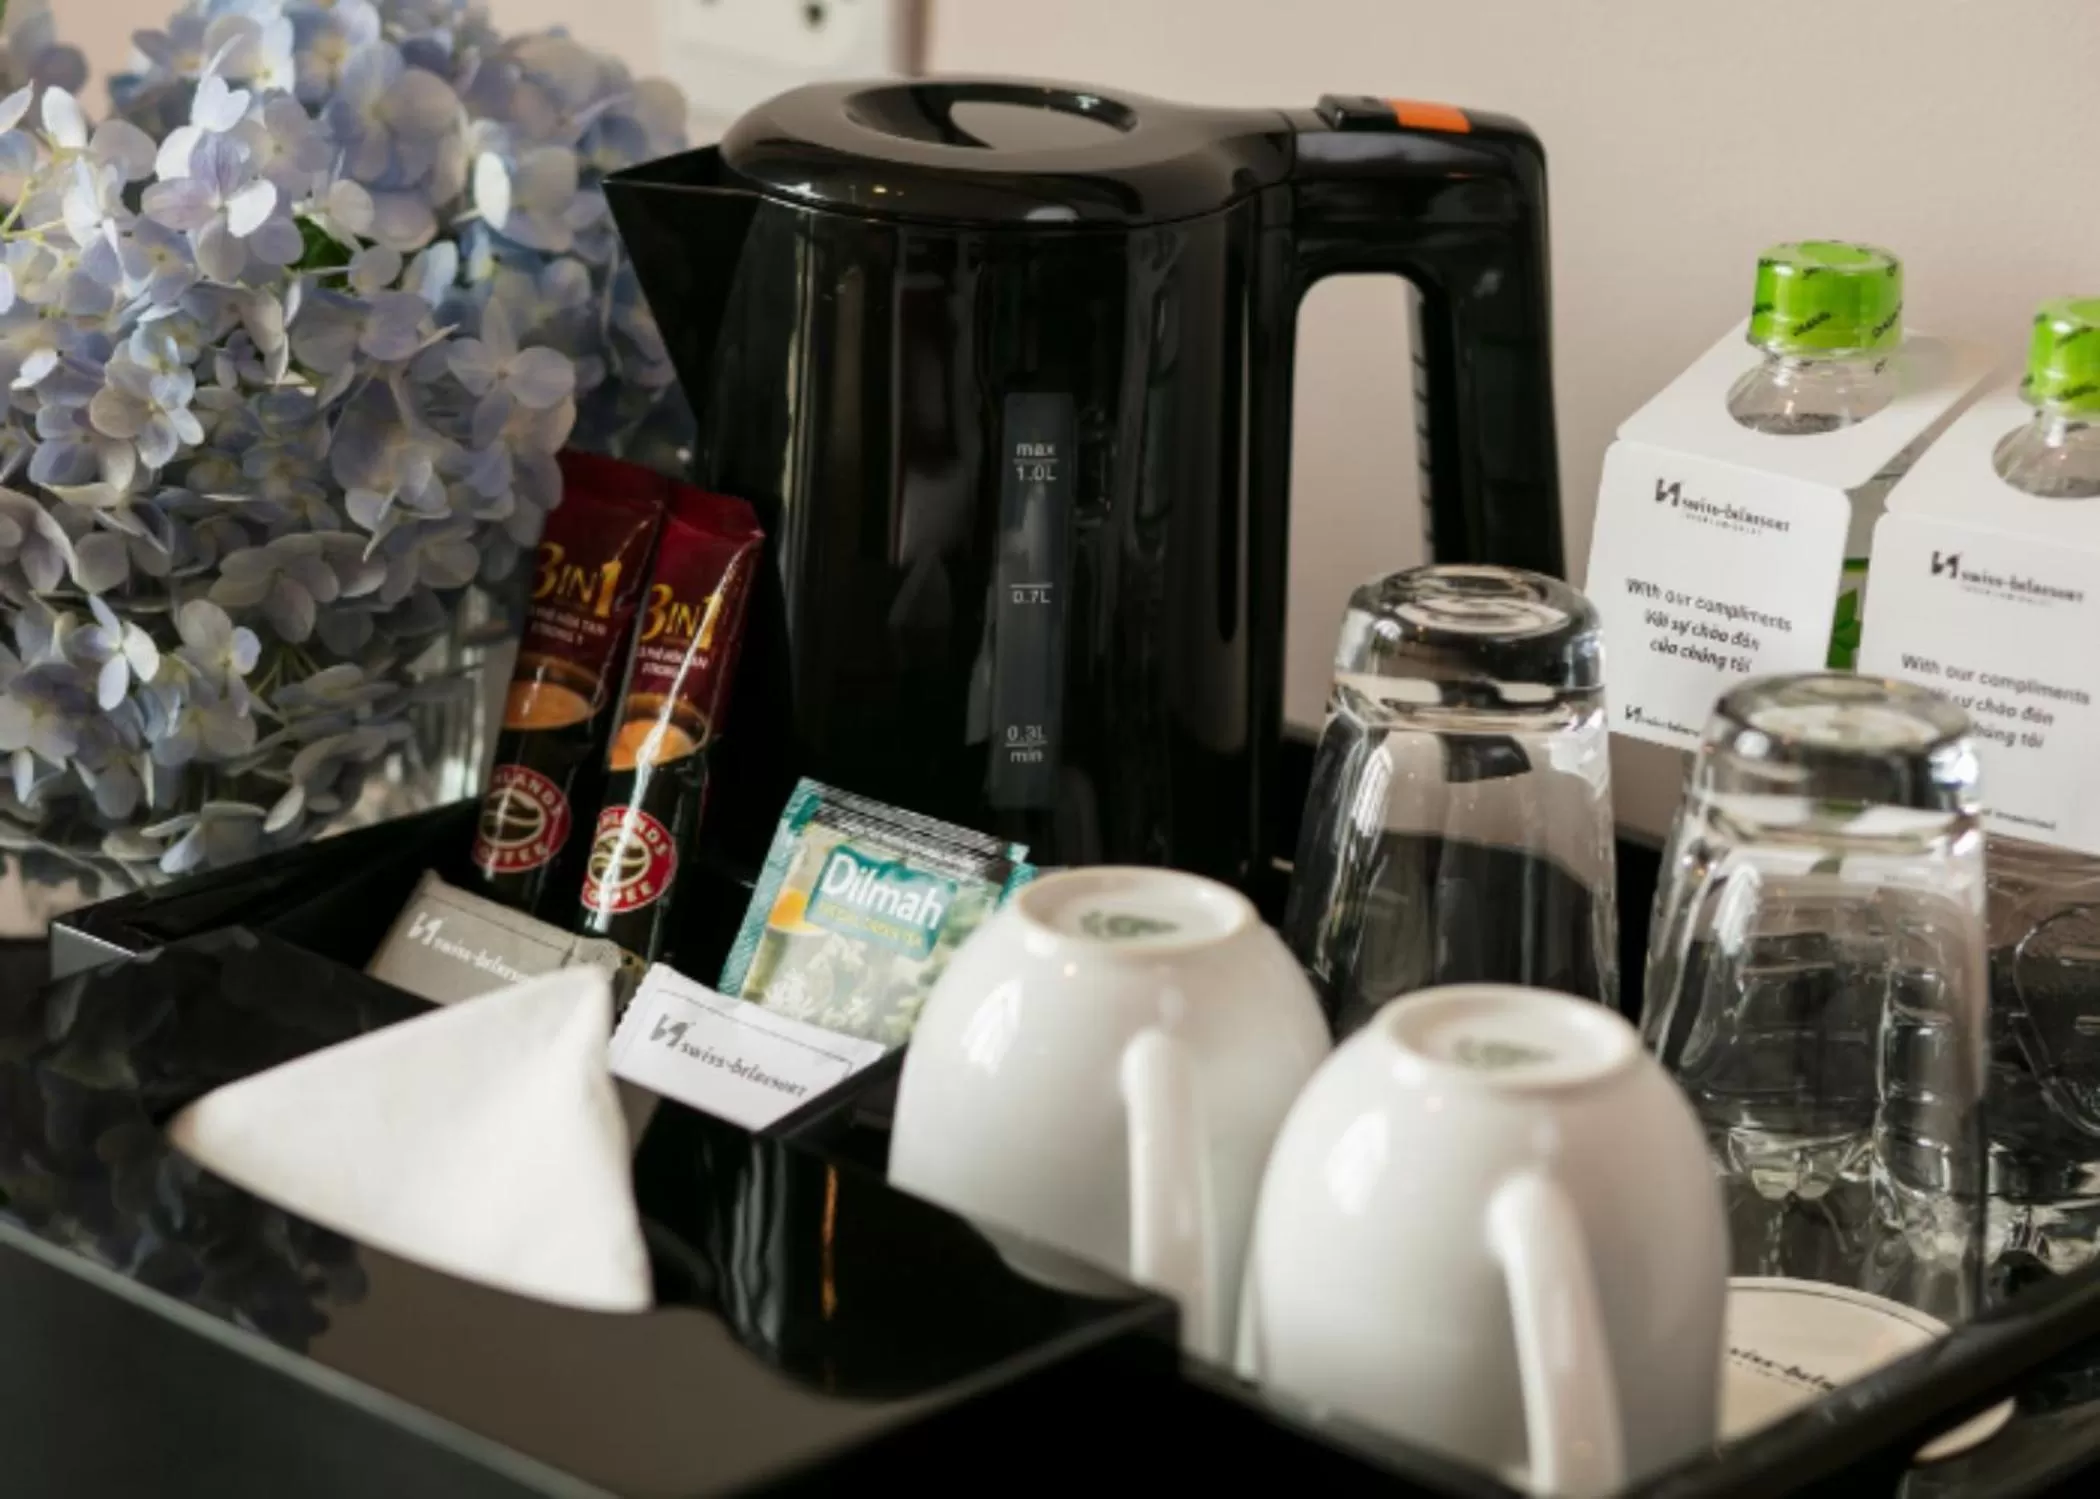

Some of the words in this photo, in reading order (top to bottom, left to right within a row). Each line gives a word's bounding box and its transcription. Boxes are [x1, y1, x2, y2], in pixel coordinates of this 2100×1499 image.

[1015, 443, 1057, 457] max
[1015, 464, 1058, 481] 1.0L
[1012, 590, 1052, 604] 0.7L
[1625, 578, 1661, 600] With
[1664, 589, 1692, 607] our
[1695, 597, 1793, 632] compliments
[1902, 653, 1941, 675] With
[1945, 665, 1976, 682] our
[1979, 671, 2091, 706] compliments
[1972, 720, 2017, 748] húng
[1010, 750, 1044, 764] min
[820, 850, 945, 930] Dilmah
